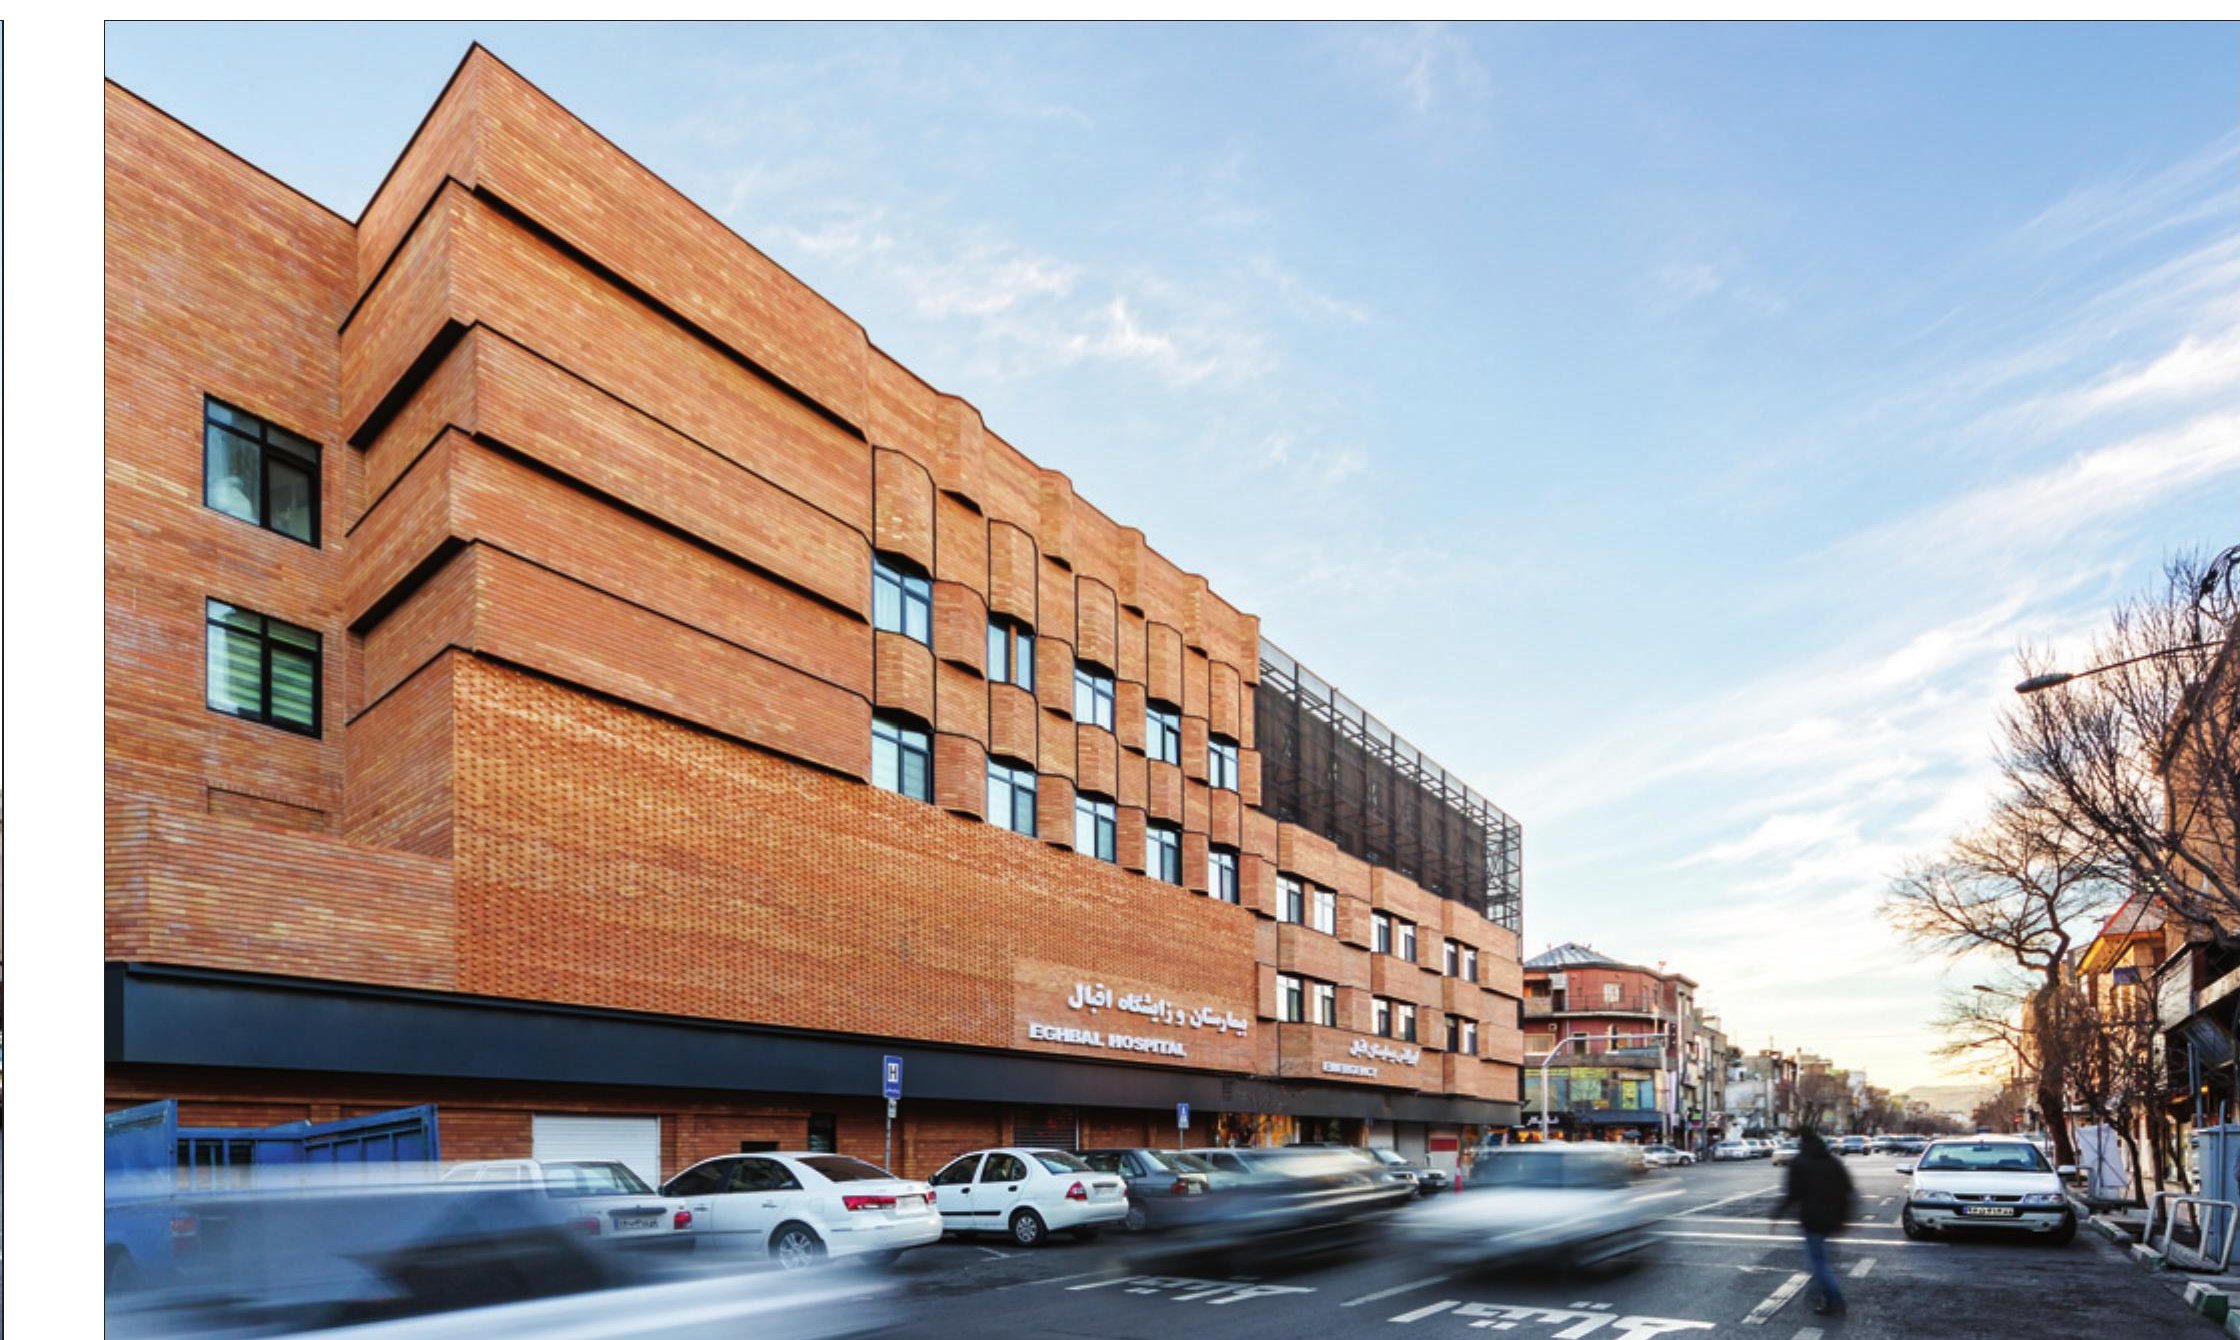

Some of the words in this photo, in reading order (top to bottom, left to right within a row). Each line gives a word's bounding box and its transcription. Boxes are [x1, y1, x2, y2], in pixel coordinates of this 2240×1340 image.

[1067, 982, 1113, 1015] اقبال
[1175, 1009, 1185, 1026] و
[1028, 1022, 1104, 1047] EGHBAL
[1107, 1033, 1188, 1057] HOSPITAL
[889, 1065, 897, 1080] H
